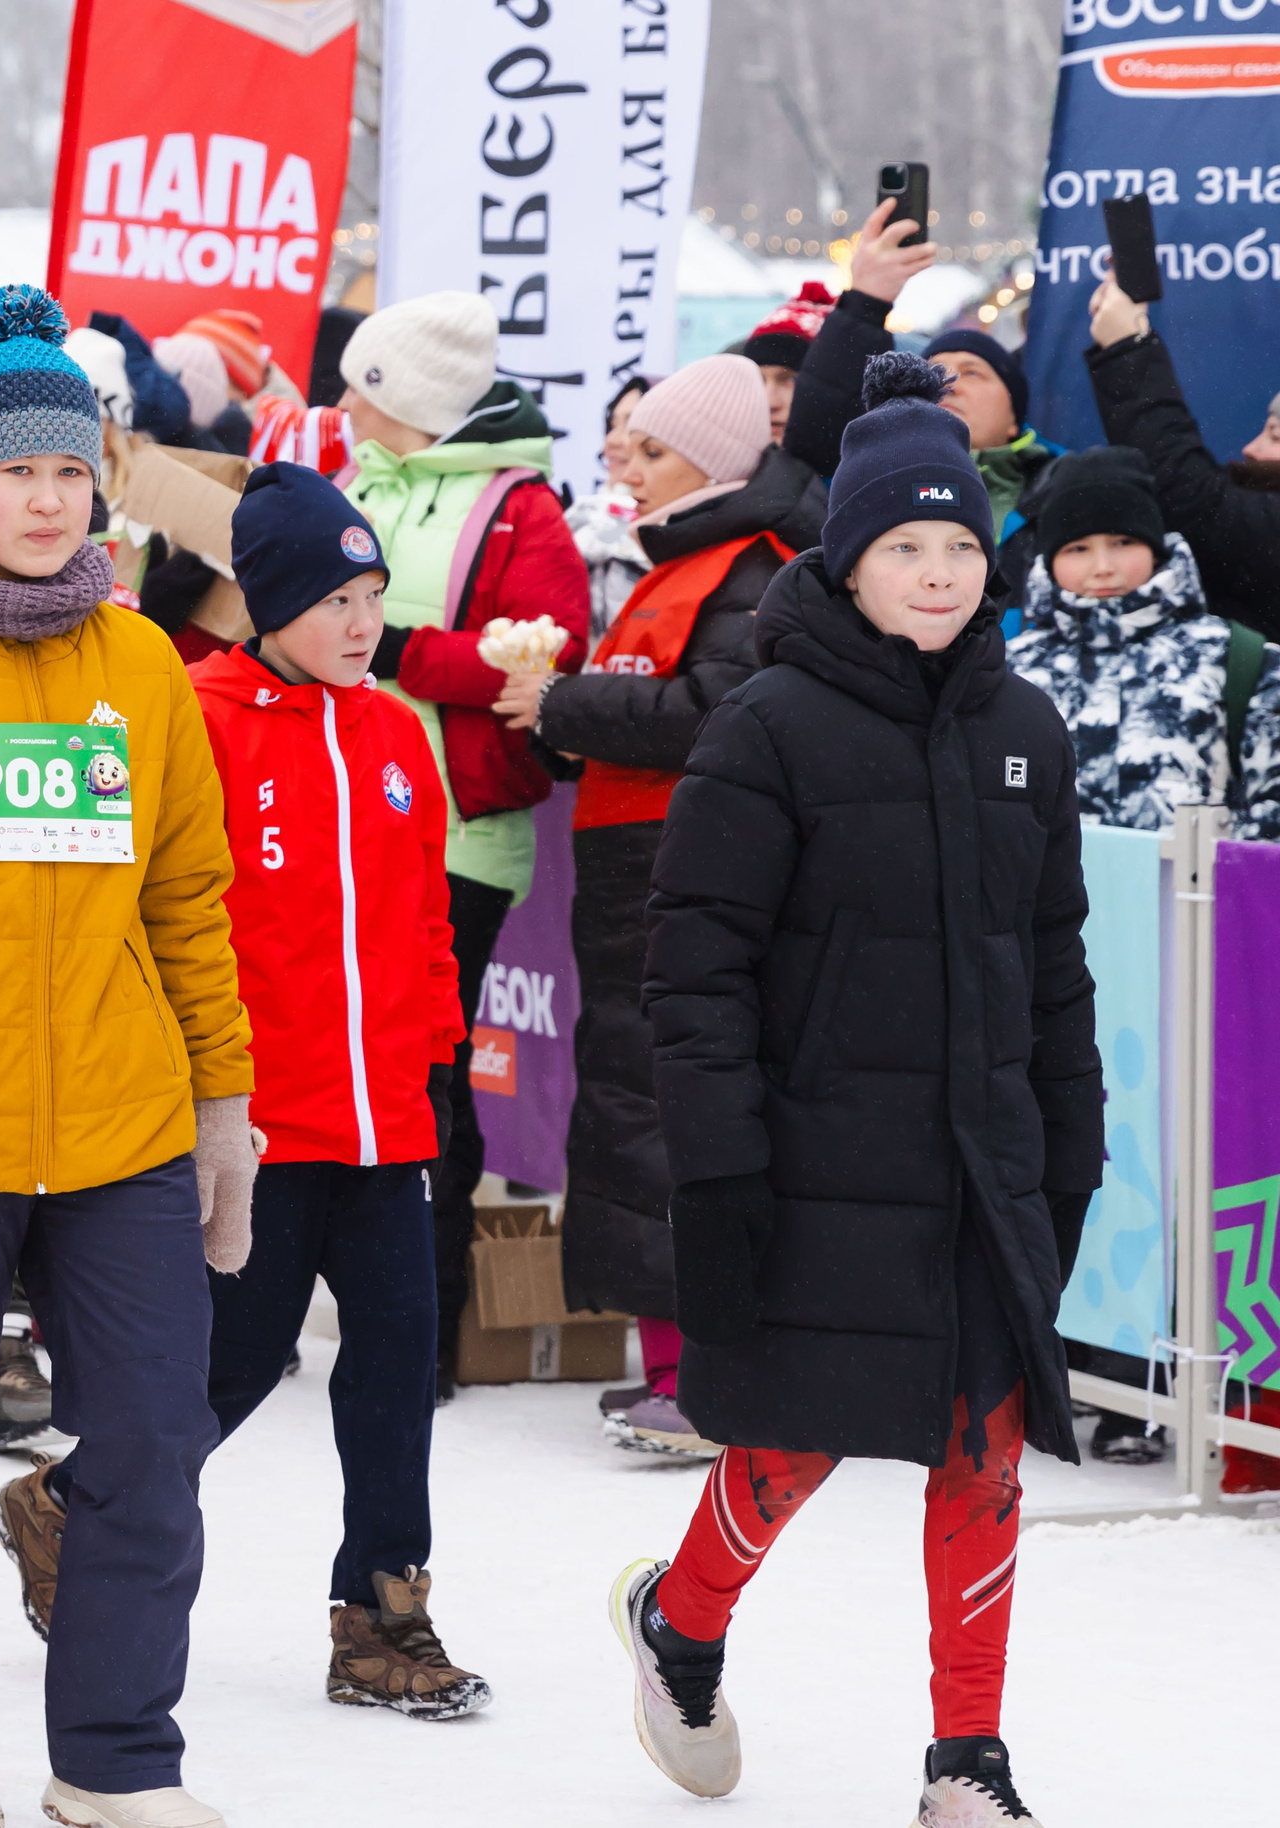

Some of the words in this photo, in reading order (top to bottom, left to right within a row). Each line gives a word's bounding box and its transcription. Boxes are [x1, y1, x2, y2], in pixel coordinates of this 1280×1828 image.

[621, 88, 671, 218] ДЛЯ
[83, 132, 319, 235] ПАПА
[1040, 165, 1180, 210] огда
[69, 219, 320, 295] ДЖОНС
[1155, 227, 1280, 283] люб
[919, 487, 954, 500] FILA
[261, 826, 285, 870] 5
